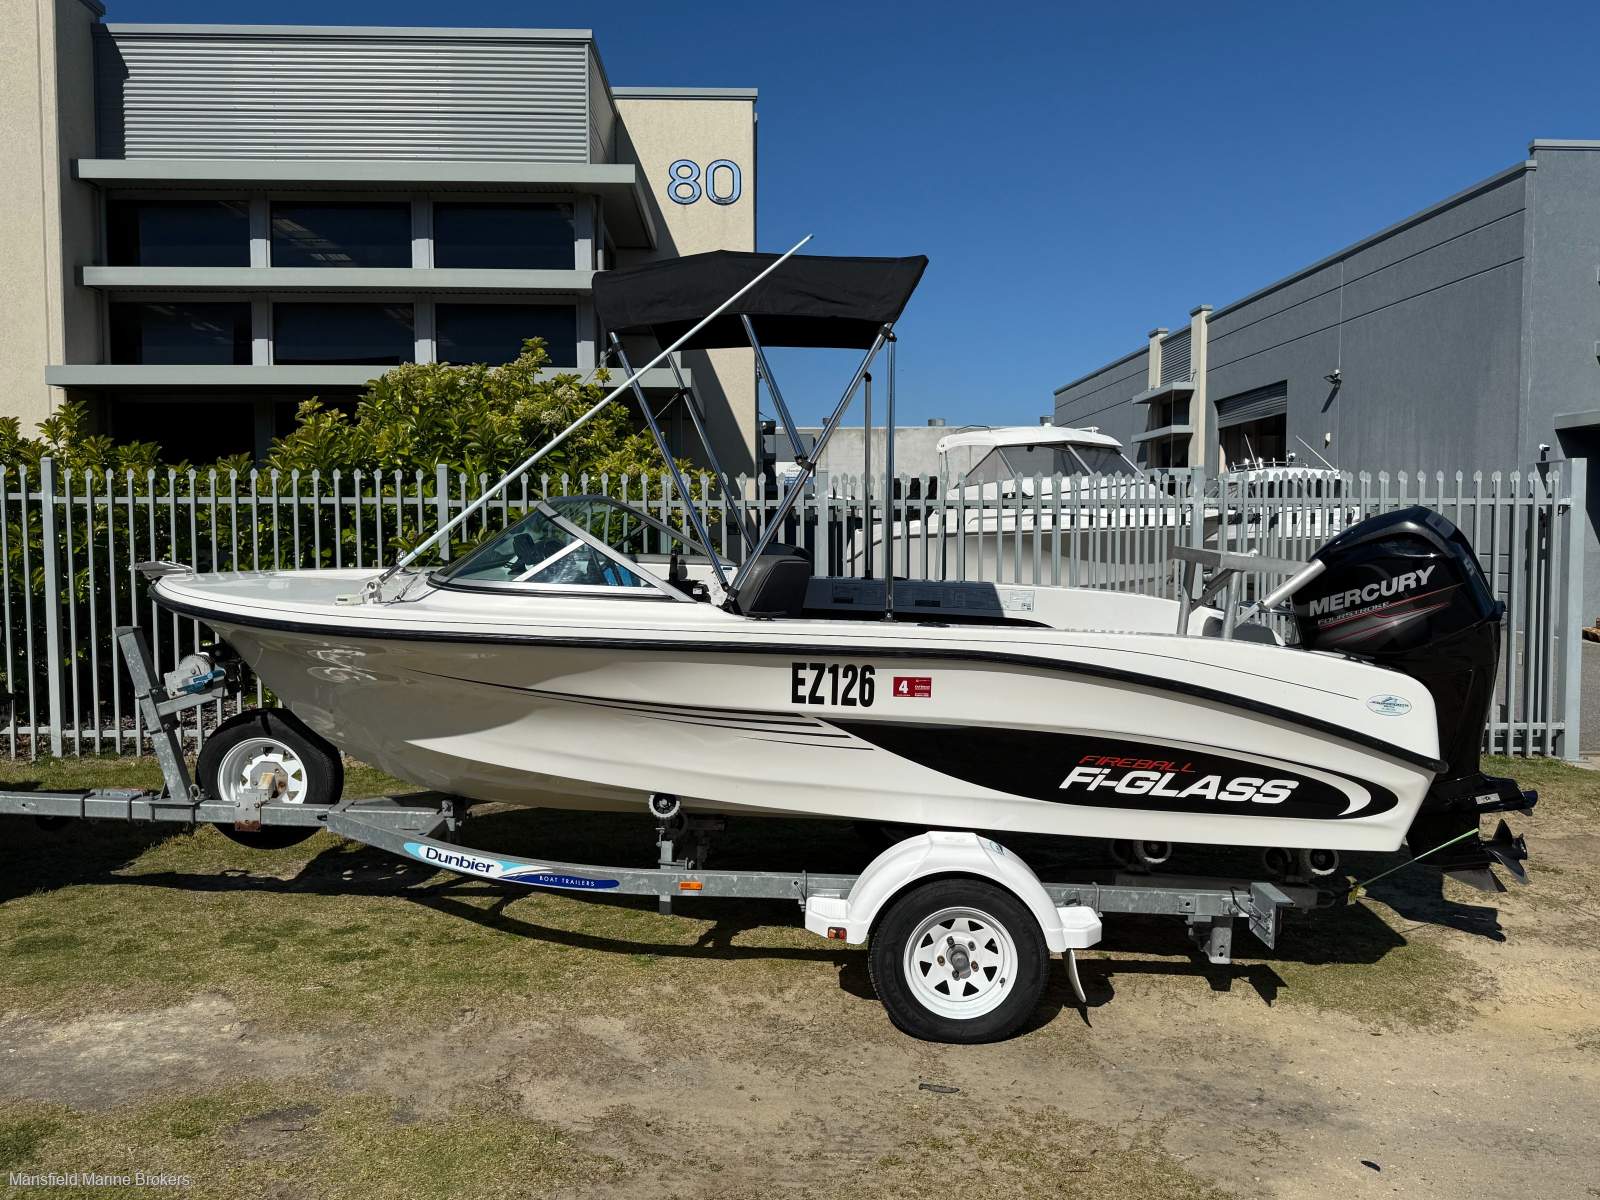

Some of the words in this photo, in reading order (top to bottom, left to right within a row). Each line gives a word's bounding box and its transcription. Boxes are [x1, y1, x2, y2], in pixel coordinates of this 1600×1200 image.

[667, 159, 742, 206] 80
[1309, 564, 1436, 617] MERCURY
[791, 662, 876, 707] EZ126
[898, 680, 909, 694] 4
[1078, 755, 1197, 773] FIREBALL
[425, 847, 495, 873] Dunbier
[539, 875, 558, 883] BOAT
[561, 877, 595, 887] TRAILERS
